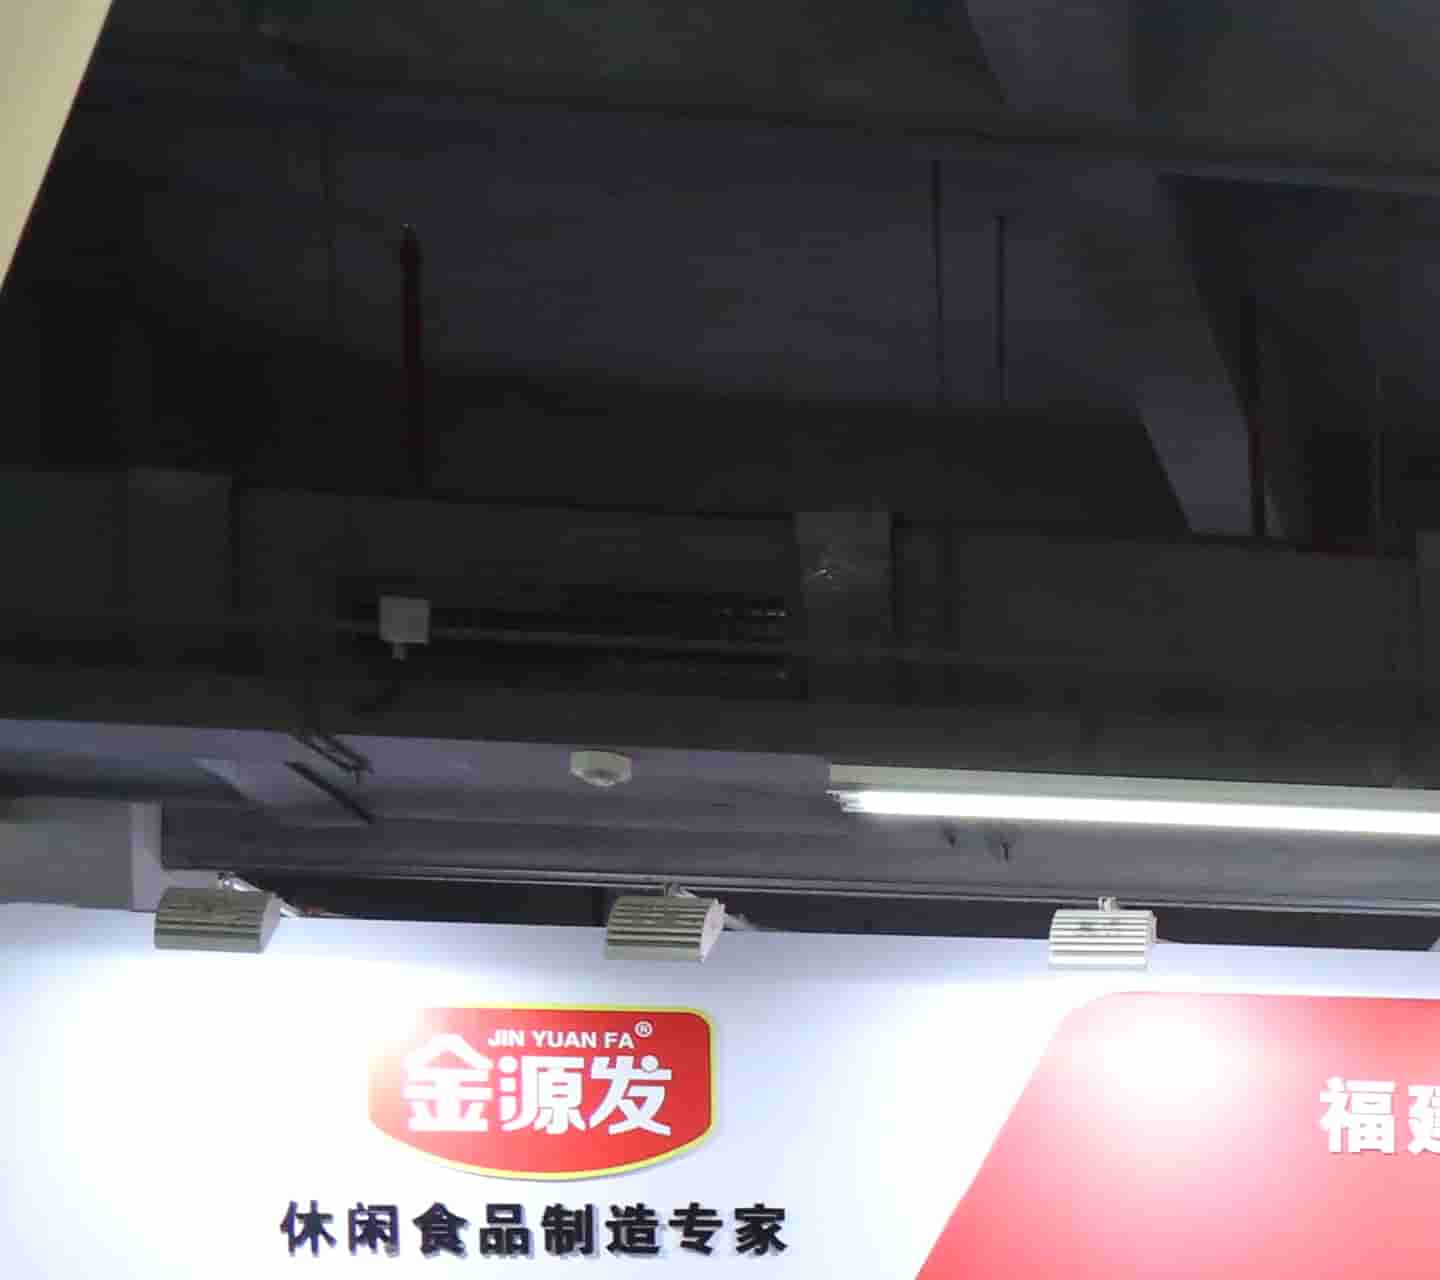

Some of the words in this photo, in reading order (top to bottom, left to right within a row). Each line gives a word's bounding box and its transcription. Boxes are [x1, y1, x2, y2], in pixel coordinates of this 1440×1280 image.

[488, 1031, 525, 1049] JIN
[532, 1031, 597, 1049] YUAN
[603, 1032, 634, 1049] FA
[402, 1034, 672, 1137] 金源发
[279, 1200, 789, 1257] 休闲食品制造专家
